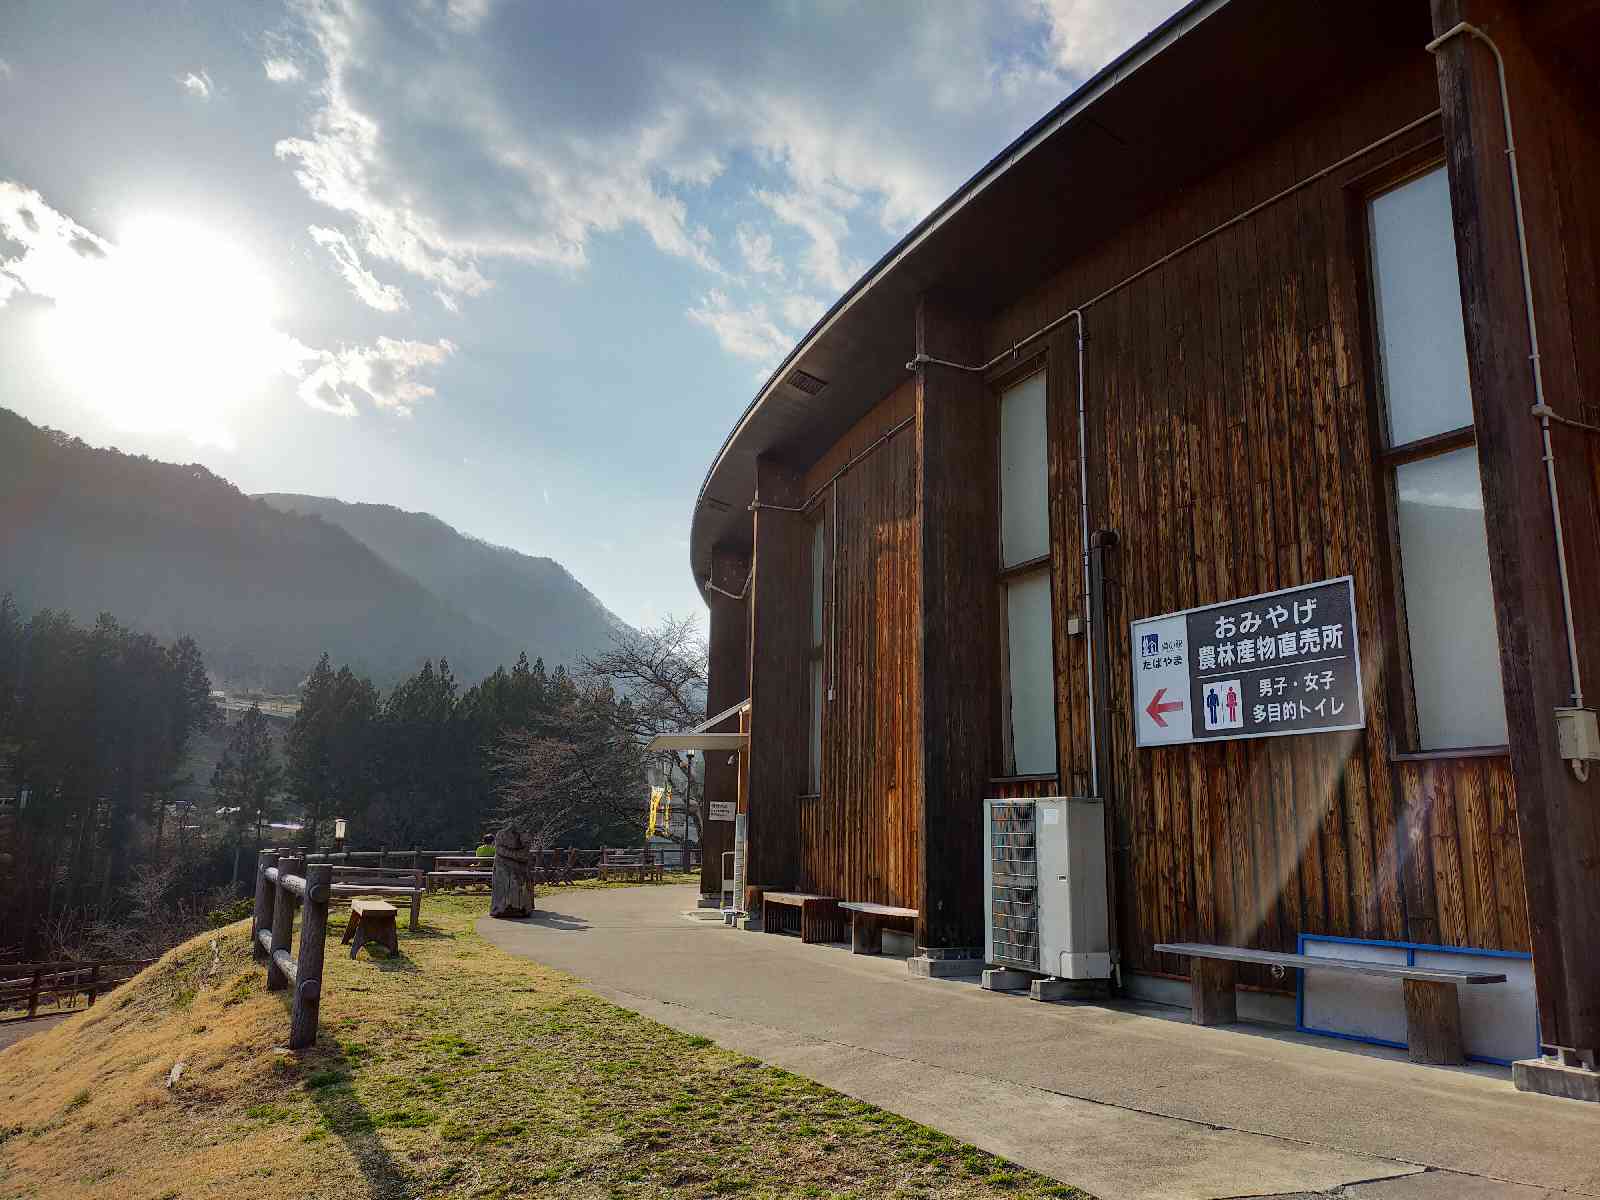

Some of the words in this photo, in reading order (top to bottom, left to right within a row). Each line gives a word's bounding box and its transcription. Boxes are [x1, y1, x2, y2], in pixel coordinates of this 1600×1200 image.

[1215, 599, 1317, 639] おみやげ
[1143, 656, 1183, 670] たばやま
[1198, 624, 1344, 671] 農林産物直売所
[1253, 697, 1345, 724] 多目的トイレ
